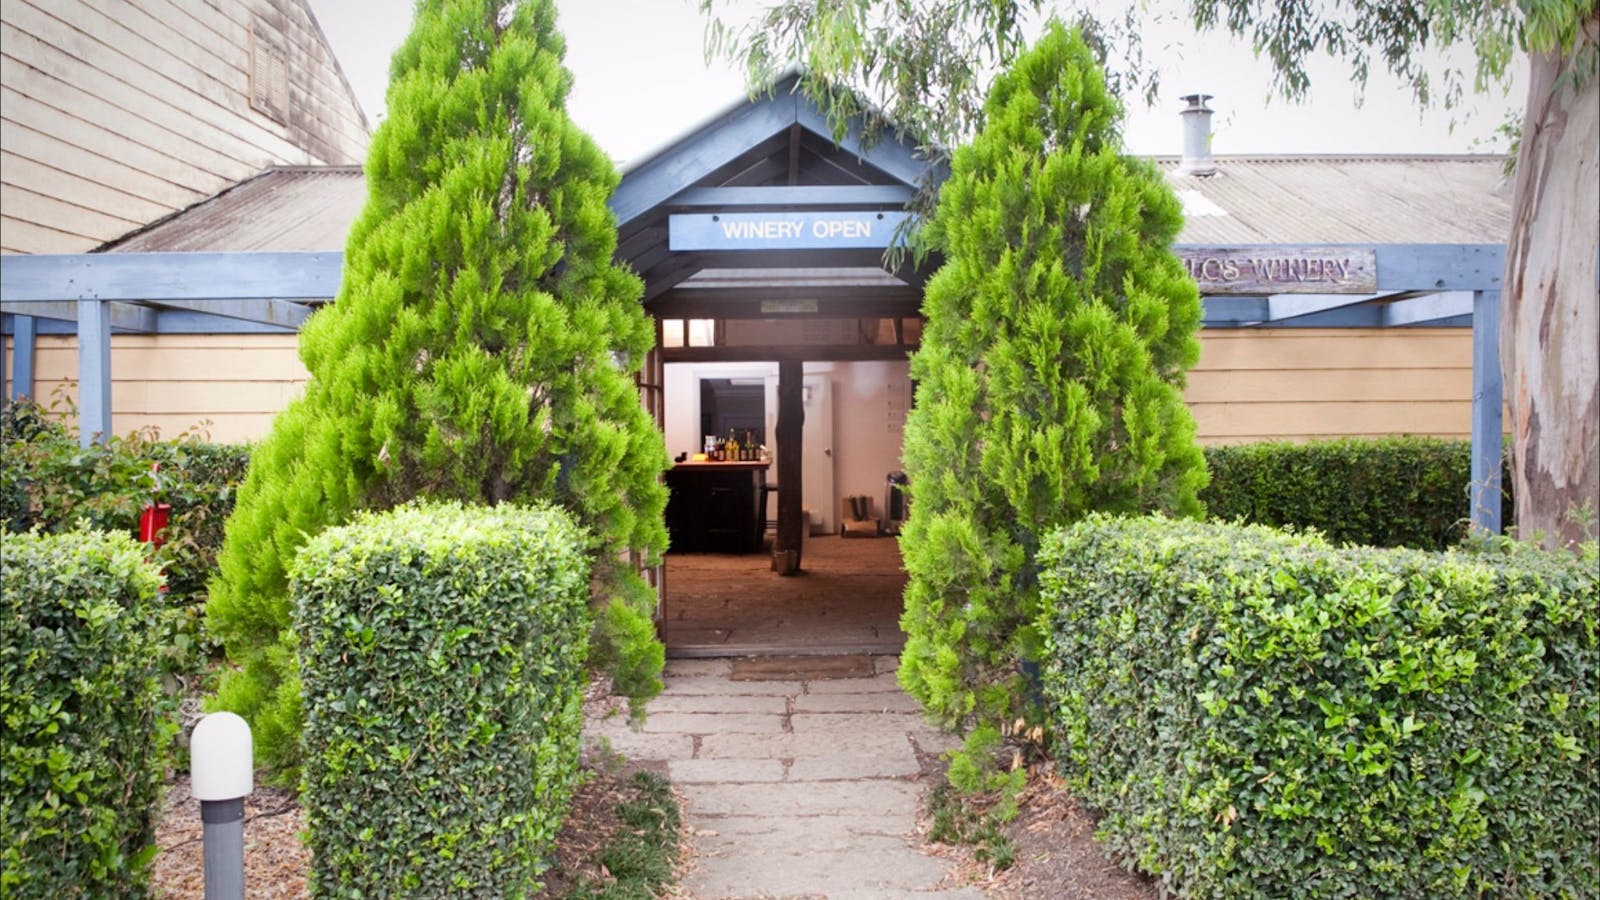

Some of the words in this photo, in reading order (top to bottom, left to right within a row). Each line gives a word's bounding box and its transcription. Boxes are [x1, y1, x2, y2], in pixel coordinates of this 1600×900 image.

[722, 221, 804, 239] WINERY
[812, 220, 871, 238] OPEN
[1249, 256, 1350, 284] WINERY
